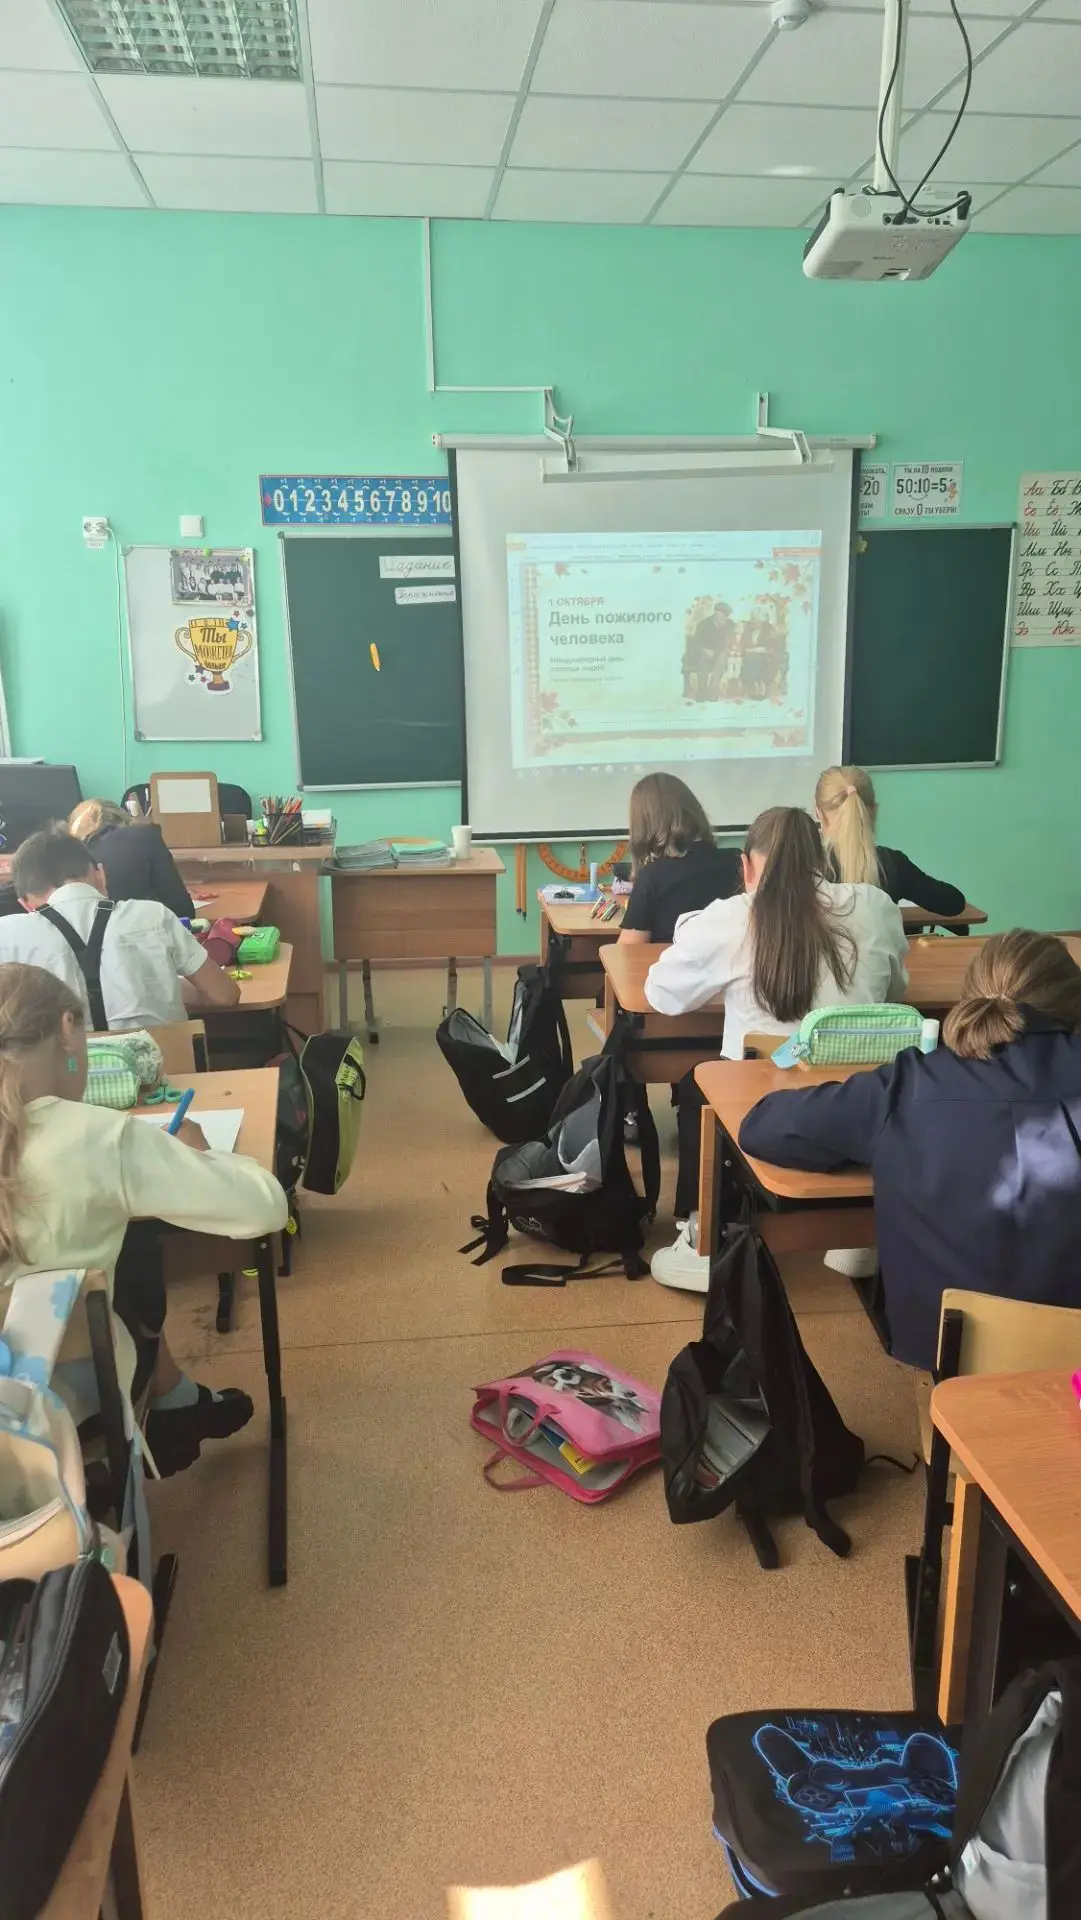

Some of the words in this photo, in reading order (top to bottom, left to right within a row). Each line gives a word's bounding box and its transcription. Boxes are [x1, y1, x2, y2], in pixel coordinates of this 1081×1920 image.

[860, 480, 880, 496] 20
[1024, 480, 1045, 496] Аа
[1050, 480, 1074, 496] Бб
[273, 489, 284, 512] 0
[289, 489, 298, 512] 1
[304, 489, 316, 512] 2
[321, 489, 332, 512] 3
[337, 489, 349, 512] 4
[354, 490, 365, 513] 5
[370, 490, 381, 513] 6
[385, 490, 396, 513] 7
[401, 490, 412, 513] 8
[417, 490, 428, 513] 9
[432, 490, 452, 513] 10
[1024, 500, 1037, 517] Ее
[1024, 520, 1040, 537] Ии
[1051, 519, 1069, 537] Йй
[1020, 541, 1047, 557] Мм
[1053, 541, 1073, 557] Нн
[1019, 561, 1035, 582] Рр
[1045, 561, 1059, 576] Сс
[1043, 580, 1066, 597] Хх
[1017, 601, 1040, 616] Шш
[1048, 601, 1074, 619] Щщ
[548, 611, 590, 628] День
[595, 611, 672, 625] пожилого
[1015, 620, 1029, 636] Ээ
[1052, 619, 1075, 635] Юю
[200, 627, 228, 644] Ты
[550, 633, 625, 645] человека
